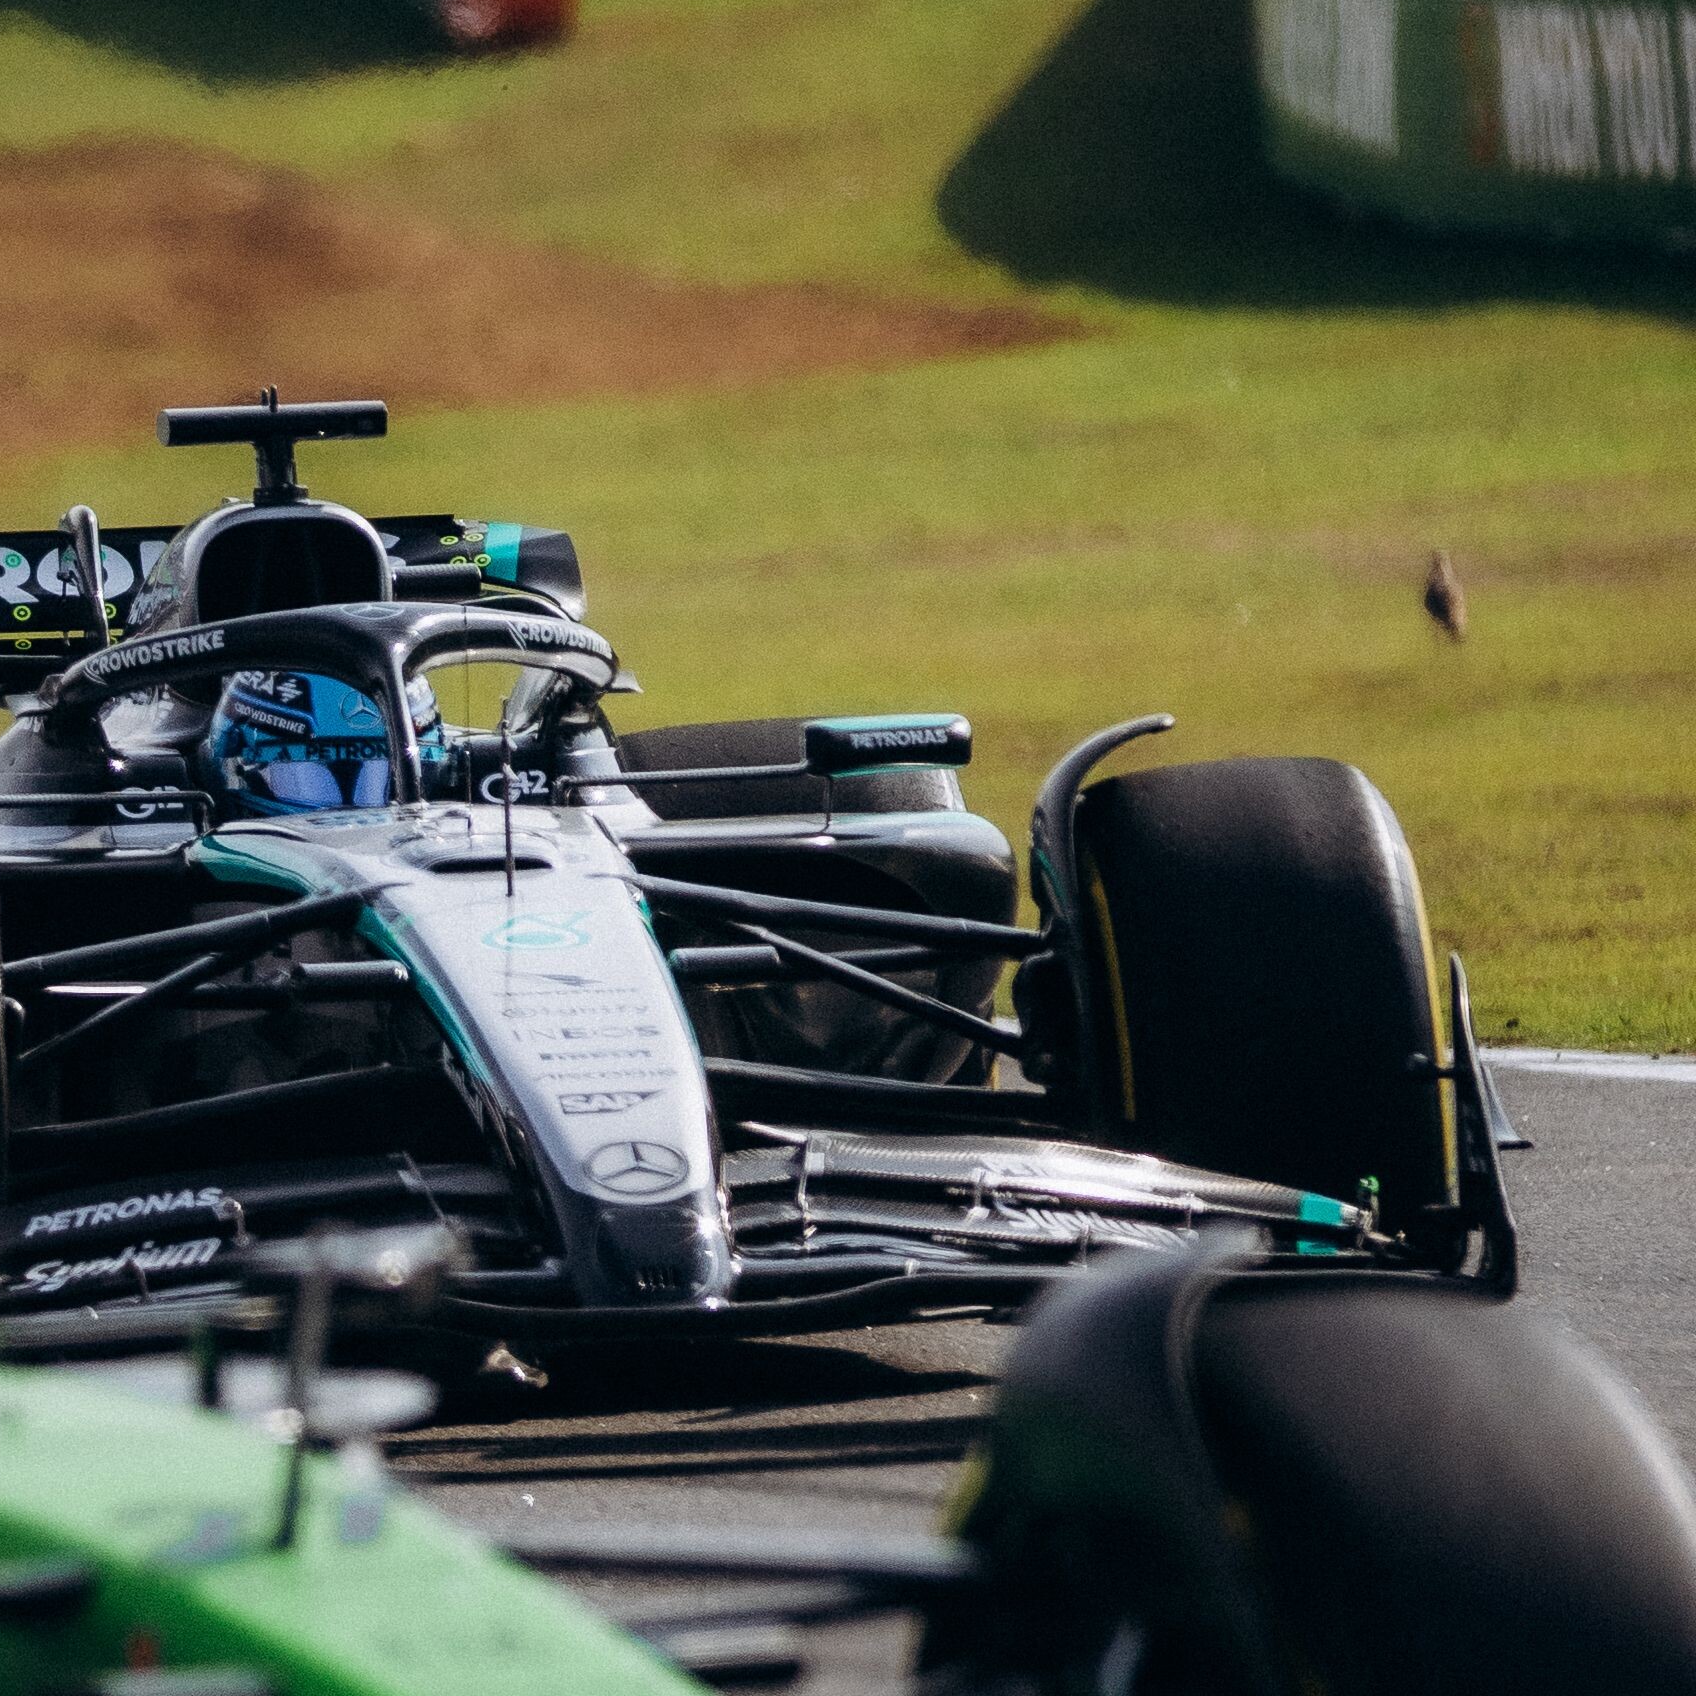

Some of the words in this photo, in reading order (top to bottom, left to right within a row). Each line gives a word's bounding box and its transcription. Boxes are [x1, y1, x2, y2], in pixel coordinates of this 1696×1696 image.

[88, 629, 225, 675] CROWDSTRIKE
[307, 741, 390, 760] PETRON
[849, 729, 948, 749] PETRONAS
[481, 769, 550, 805] G42
[513, 1025, 661, 1043] INEOS
[23, 1186, 224, 1238] PETRONAS
